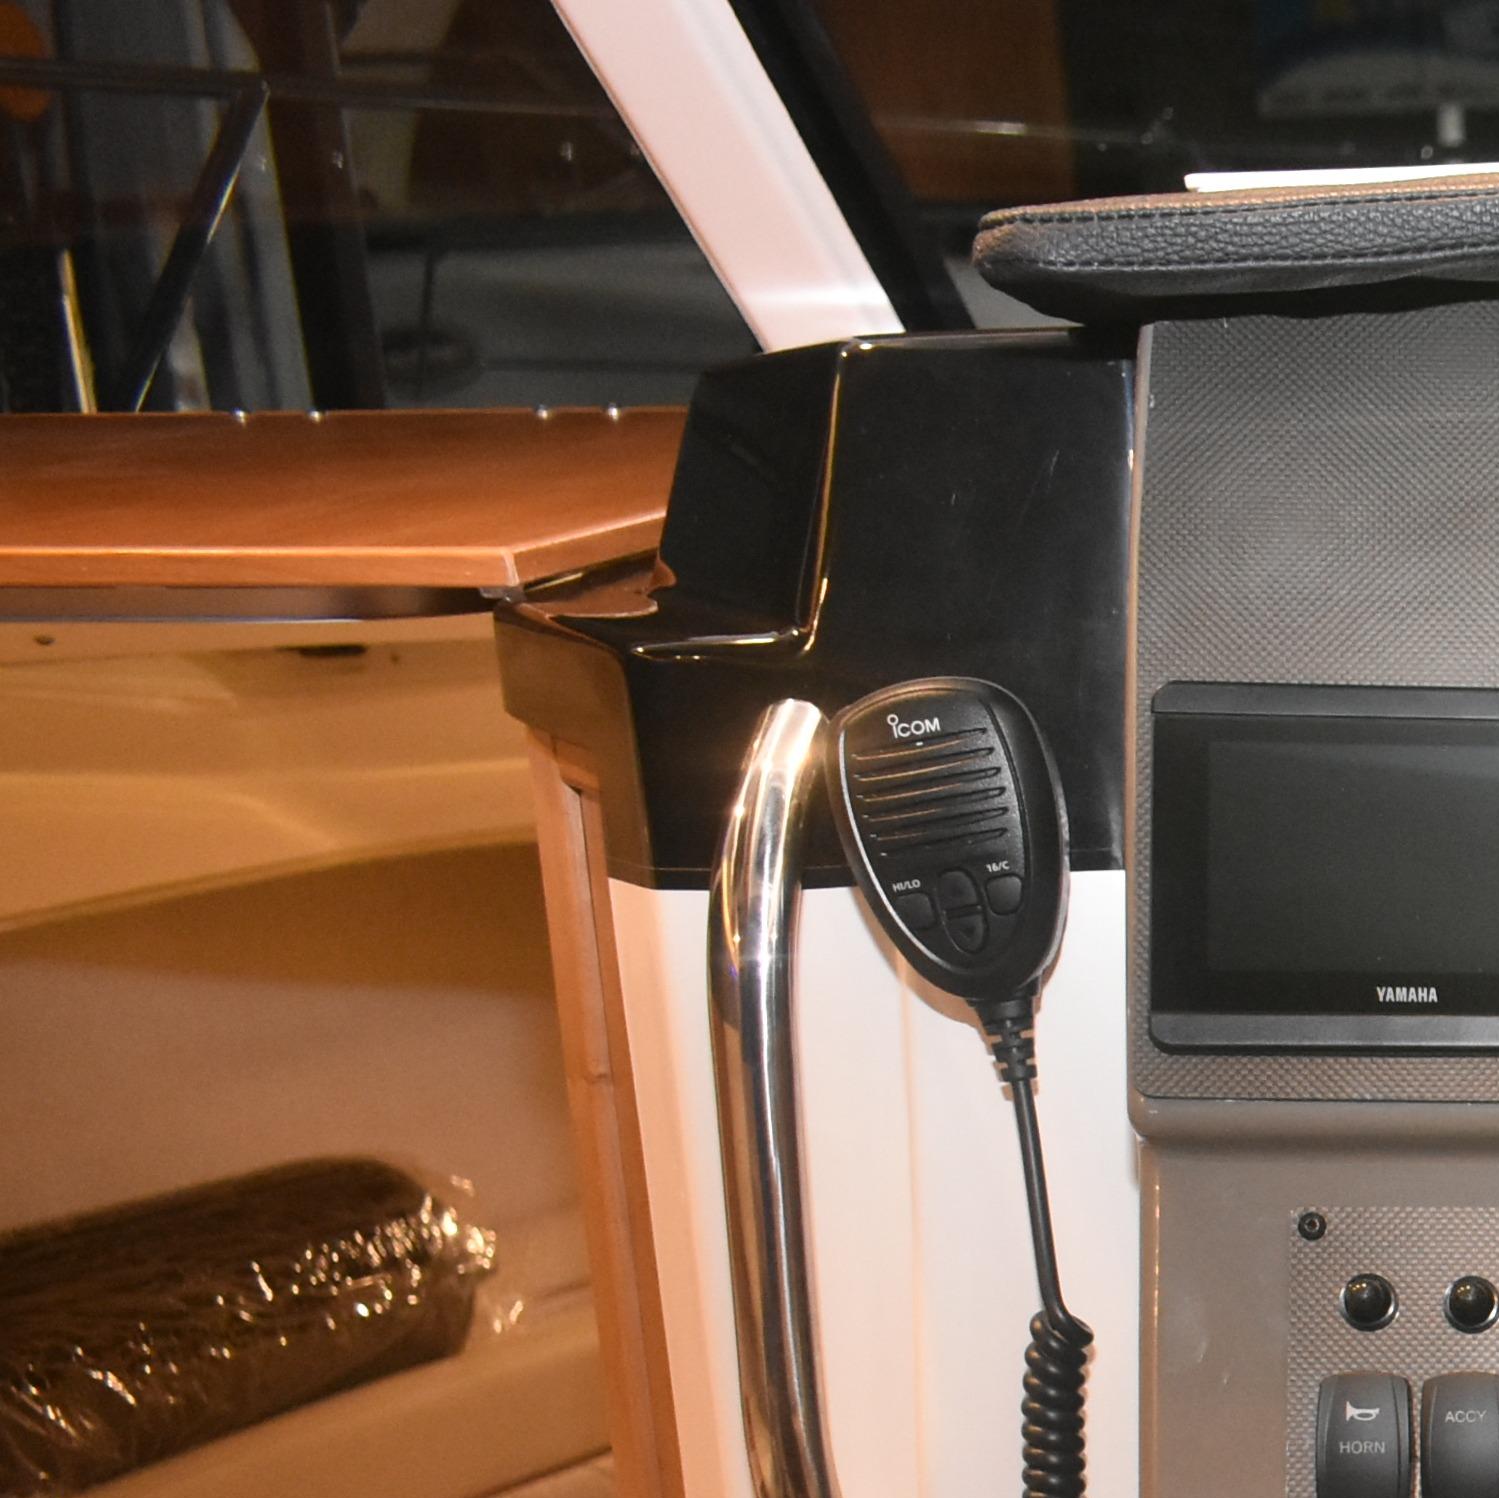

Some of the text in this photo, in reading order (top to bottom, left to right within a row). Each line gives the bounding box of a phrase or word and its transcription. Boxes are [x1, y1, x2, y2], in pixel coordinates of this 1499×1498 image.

[986, 860, 1010, 873] 16/C
[892, 878, 921, 892] HI/LO
[1376, 986, 1438, 1003] YAMAHA
[1445, 1409, 1487, 1423] ACCY
[1339, 1440, 1386, 1454] HORN
